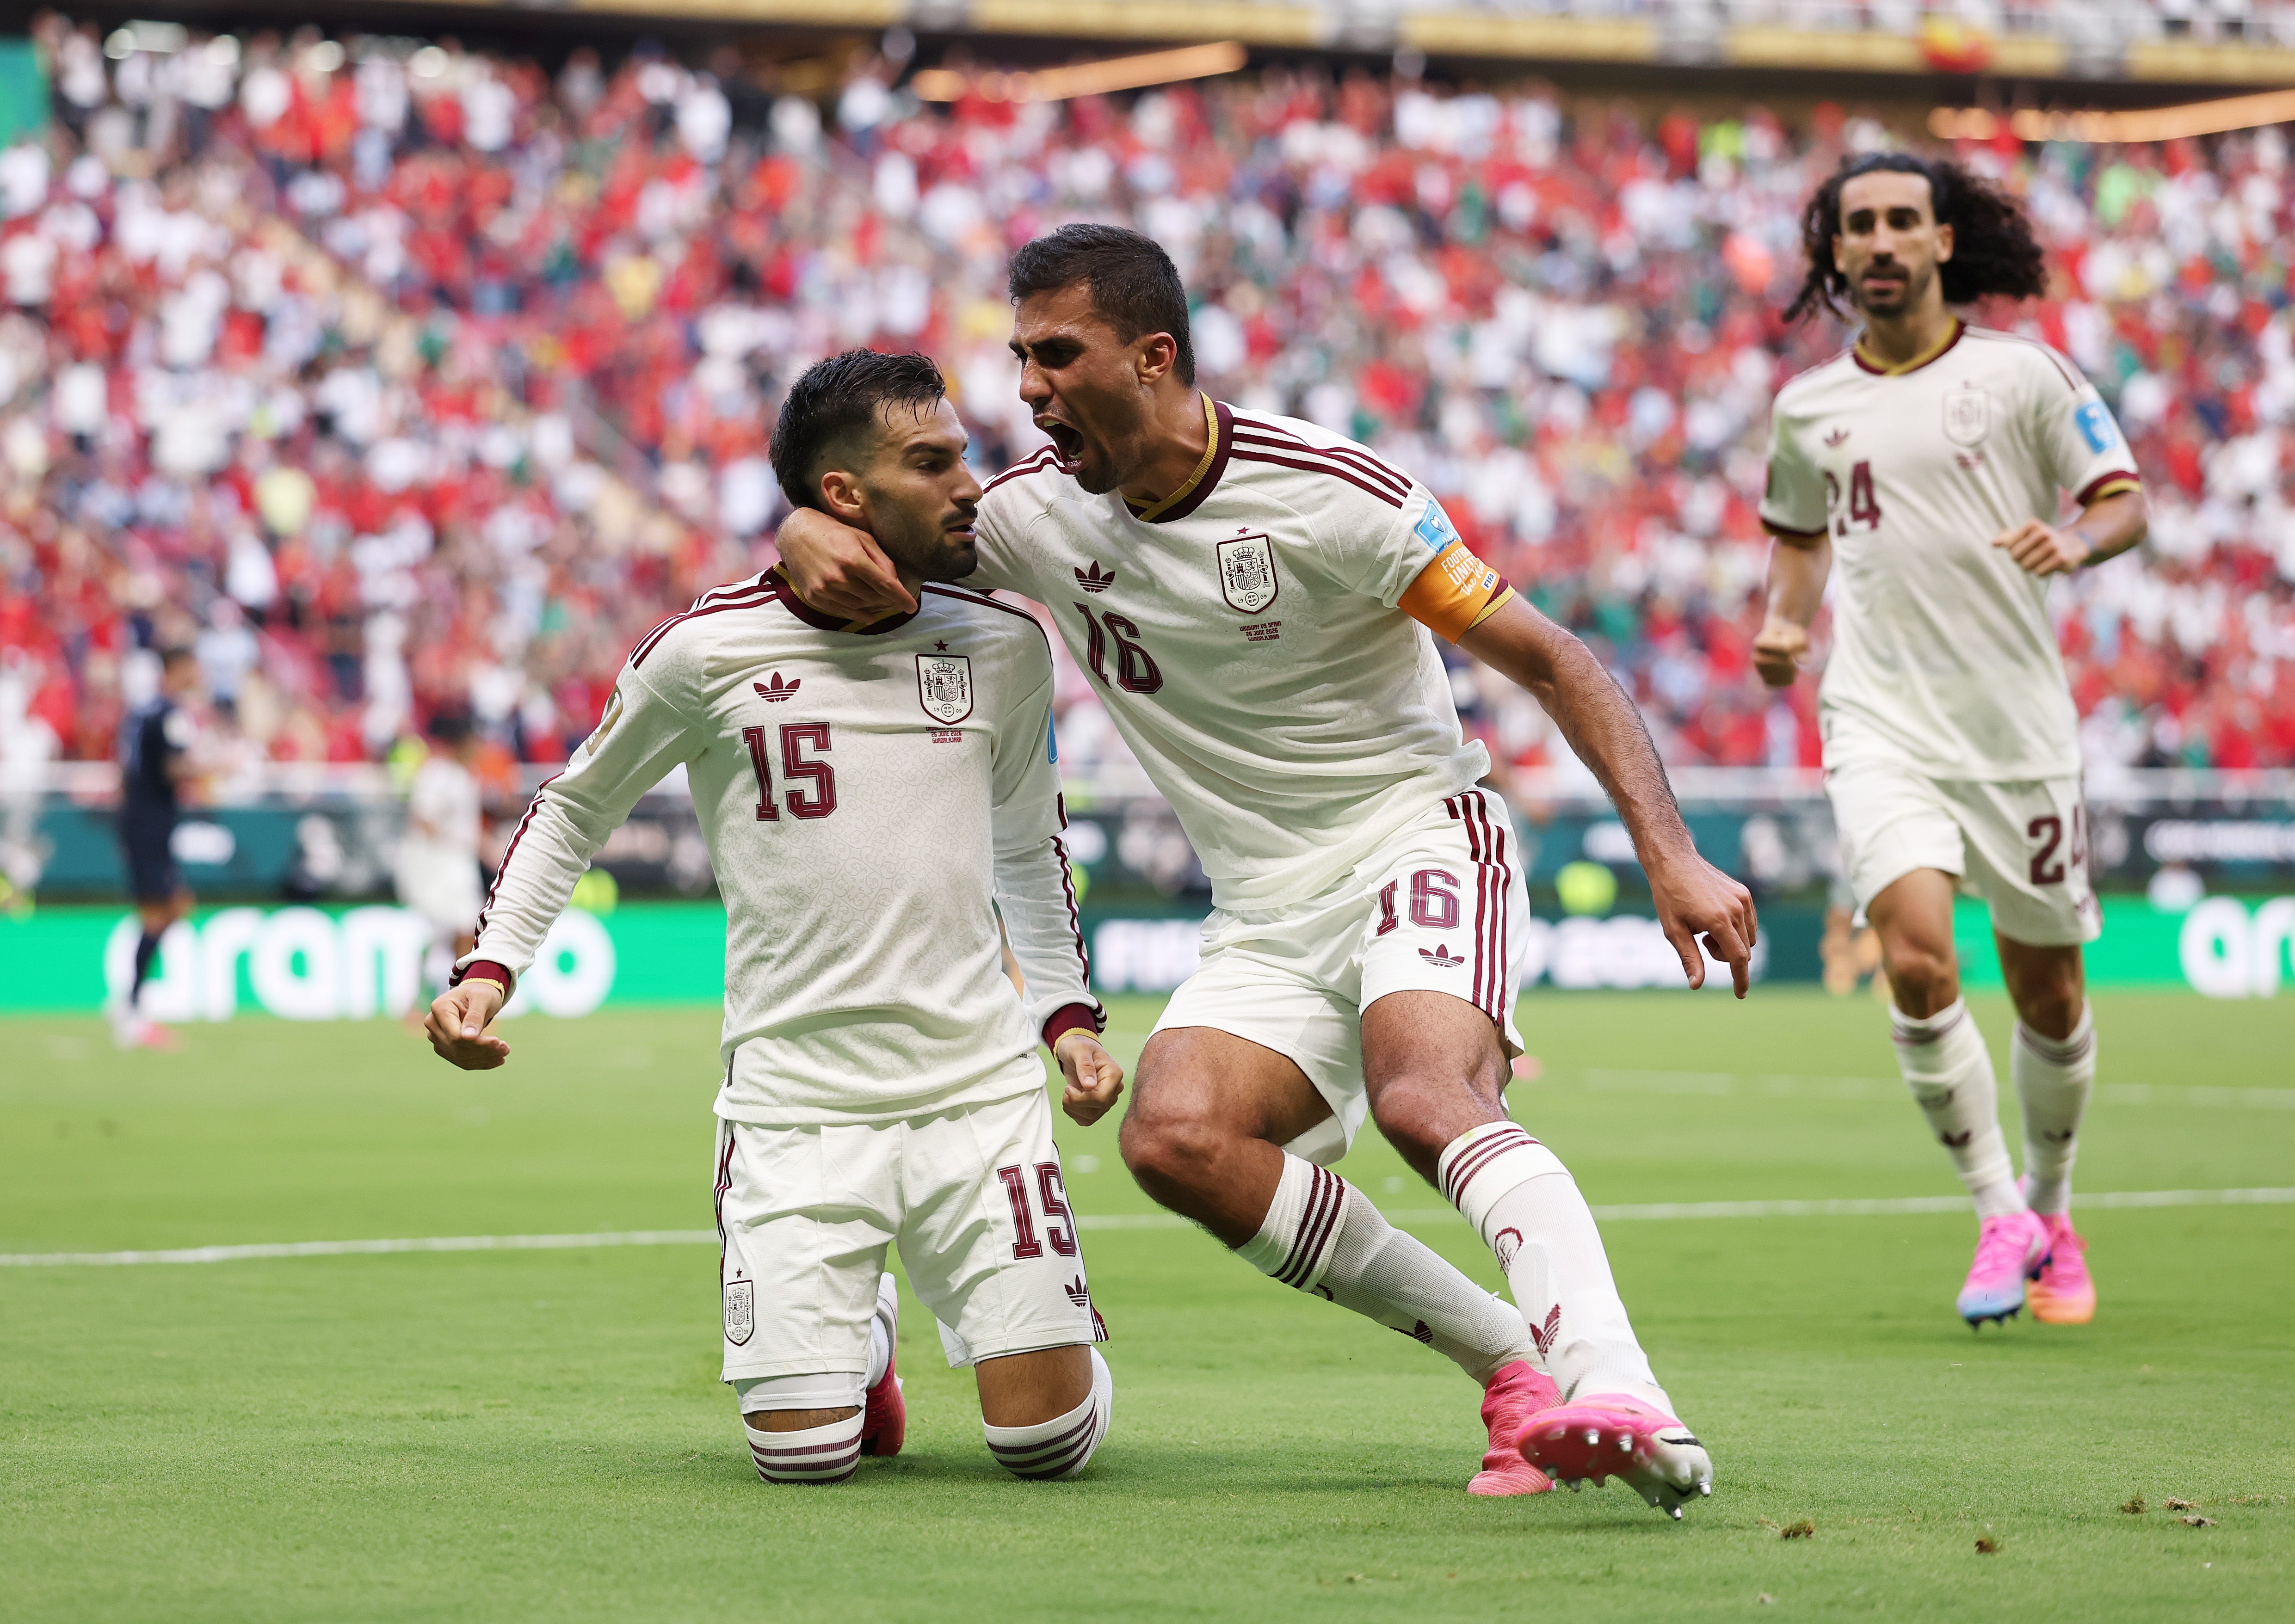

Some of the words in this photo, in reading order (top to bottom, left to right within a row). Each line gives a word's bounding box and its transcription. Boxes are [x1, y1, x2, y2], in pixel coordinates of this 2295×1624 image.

[1483, 573, 1494, 588] FIFA
[1073, 602, 1163, 694] 16
[742, 722, 837, 821] 15
[1376, 868, 1460, 937] 16
[104, 904, 616, 1022] aramo
[997, 1162, 1078, 1260] 15
